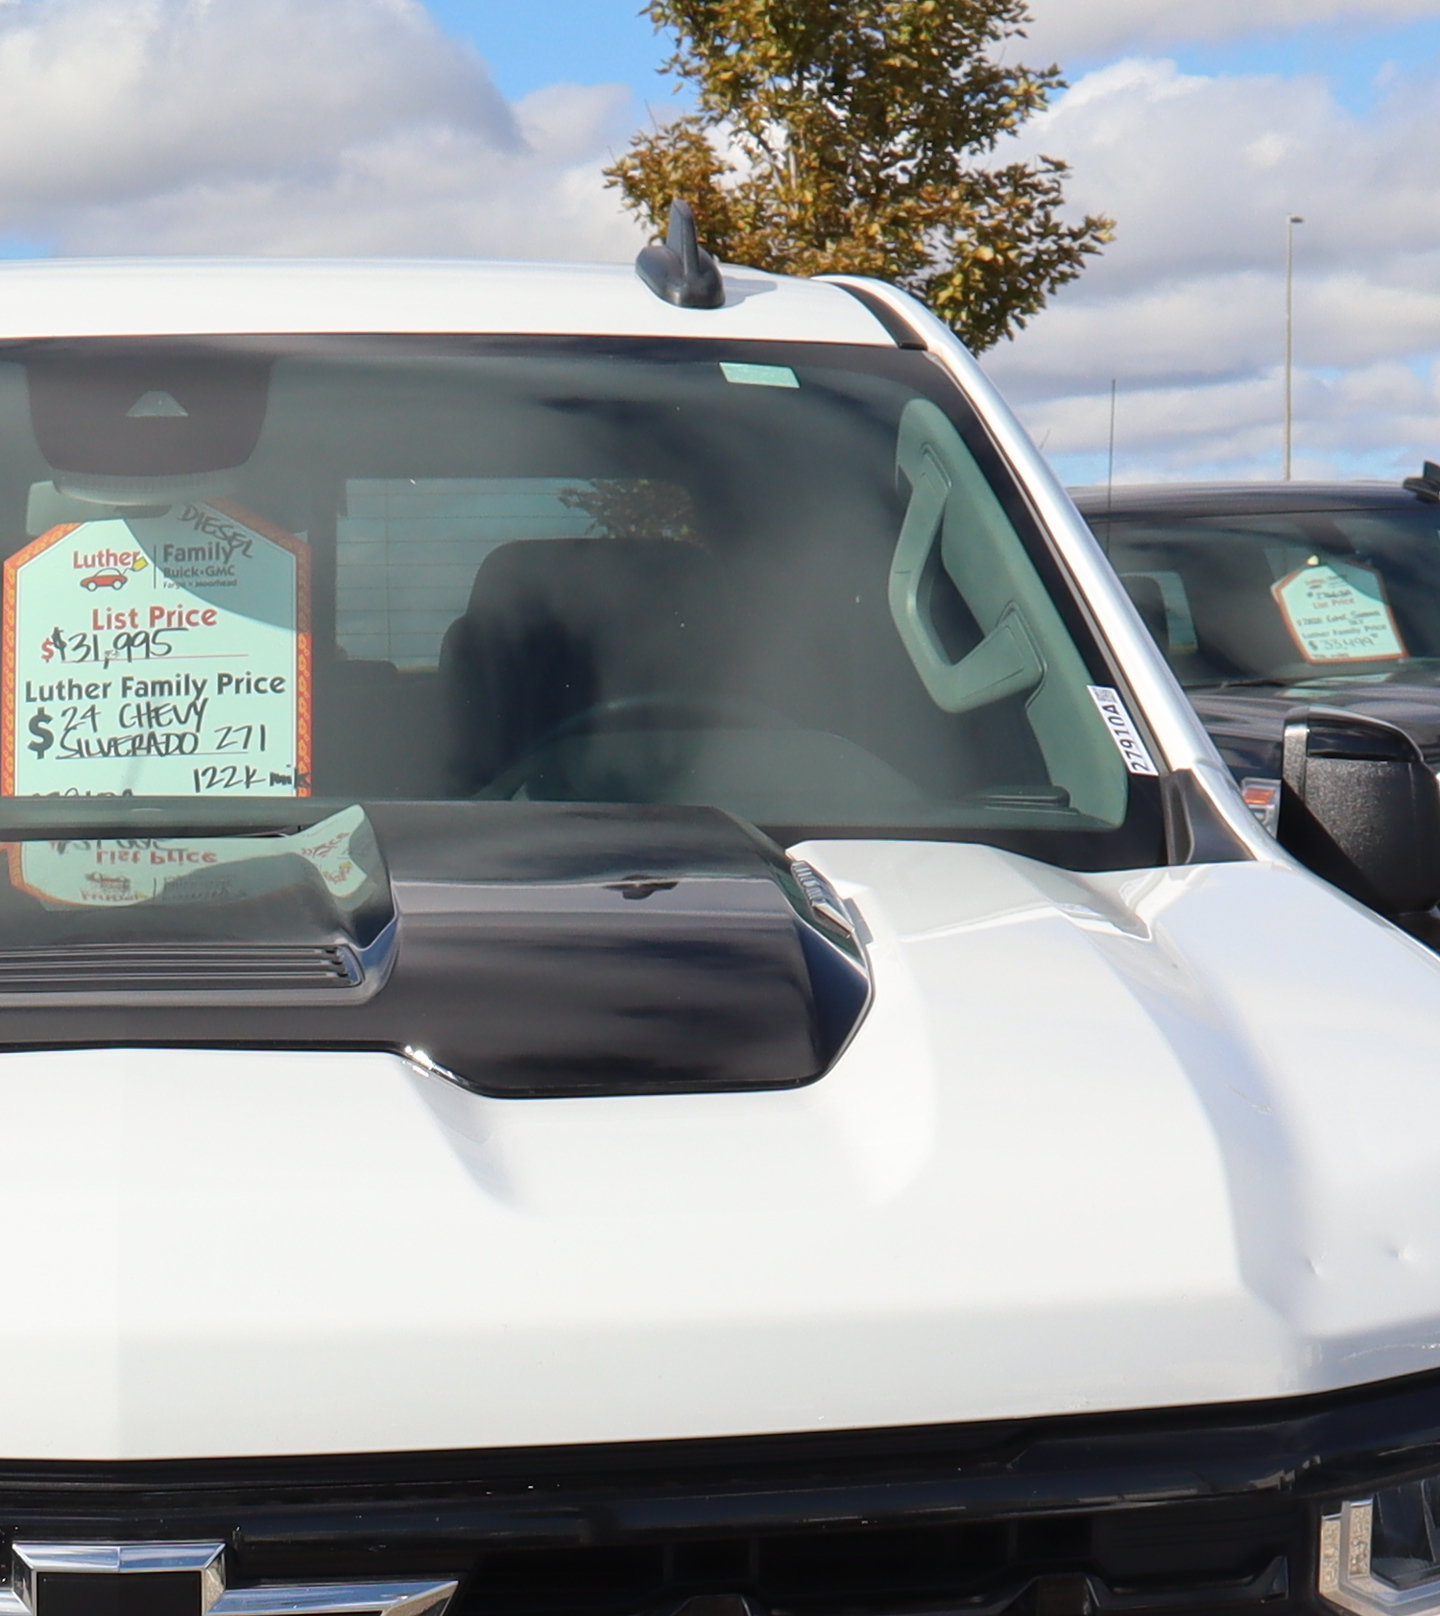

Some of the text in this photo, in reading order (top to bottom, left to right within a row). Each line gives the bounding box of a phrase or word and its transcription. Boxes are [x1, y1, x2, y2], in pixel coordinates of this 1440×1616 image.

[177, 503, 253, 559] DIESEL
[72, 548, 141, 570] Luther
[162, 540, 233, 565] Family
[163, 564, 236, 579] Buick GMC
[91, 603, 218, 631] List Price
[25, 671, 287, 703] Luther Family Price
[60, 697, 210, 734] 24 CHEVY
[27, 706, 55, 760] $
[57, 729, 200, 760] SILVERADO
[1102, 703, 1150, 772] 27910A
